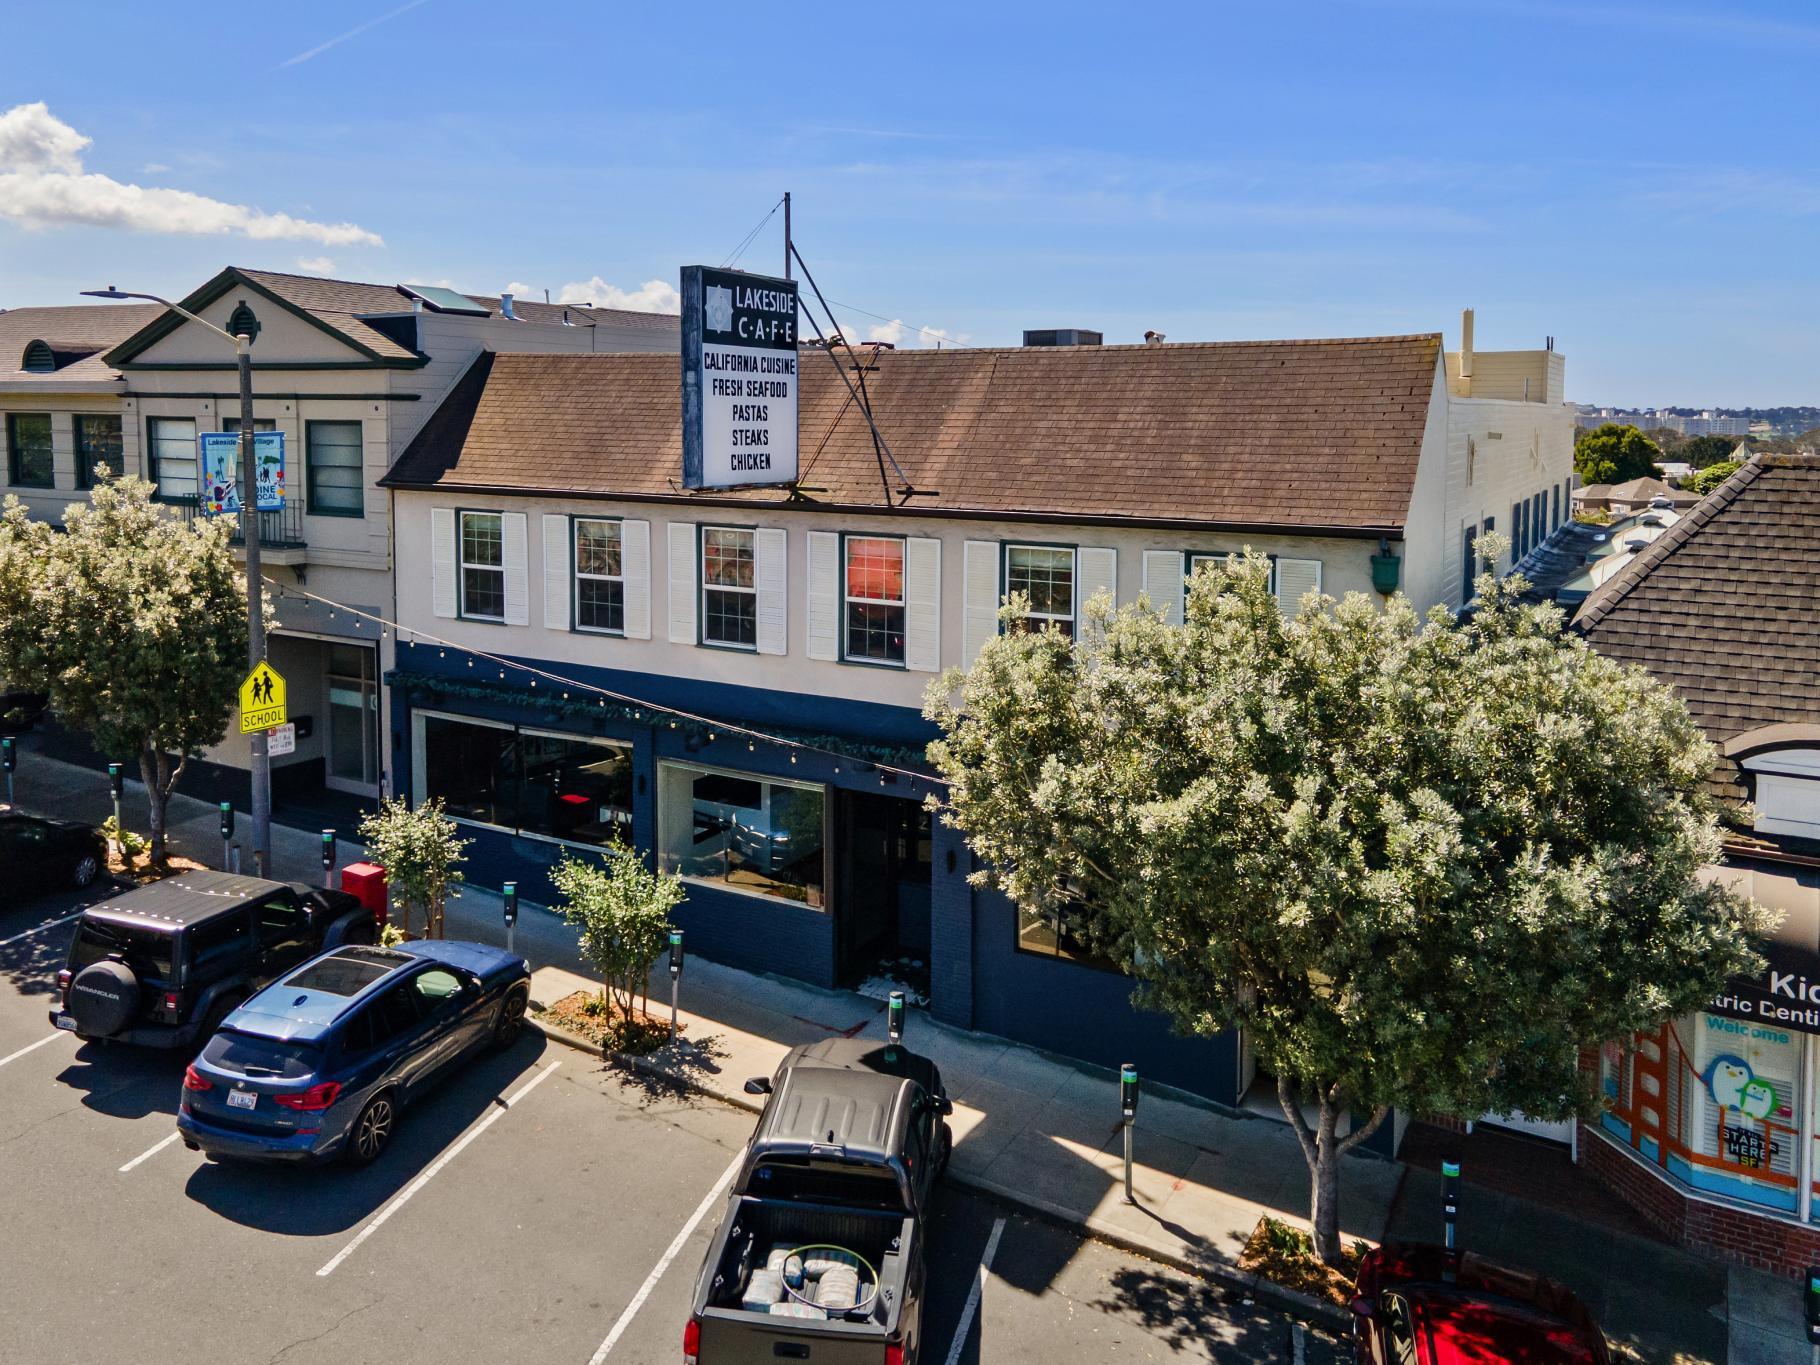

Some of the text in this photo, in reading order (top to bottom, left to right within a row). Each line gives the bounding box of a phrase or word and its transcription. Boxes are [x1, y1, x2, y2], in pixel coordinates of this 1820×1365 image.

[736, 285, 794, 314] LAKESIDE
[704, 352, 796, 375] CALIFORNIA CUISINE
[712, 378, 787, 398] FRESH SEAFOOD
[732, 404, 768, 422] PASTAS
[732, 429, 768, 446] STEAKS
[731, 453, 771, 471] CHICKEN
[244, 711, 282, 727] SCHOOL
[75, 984, 120, 1000] WRANGLER
[1706, 1015, 1790, 1044] Welcome
[1730, 1143, 1766, 1160] HERE
[1740, 1156, 1757, 1168] SF
